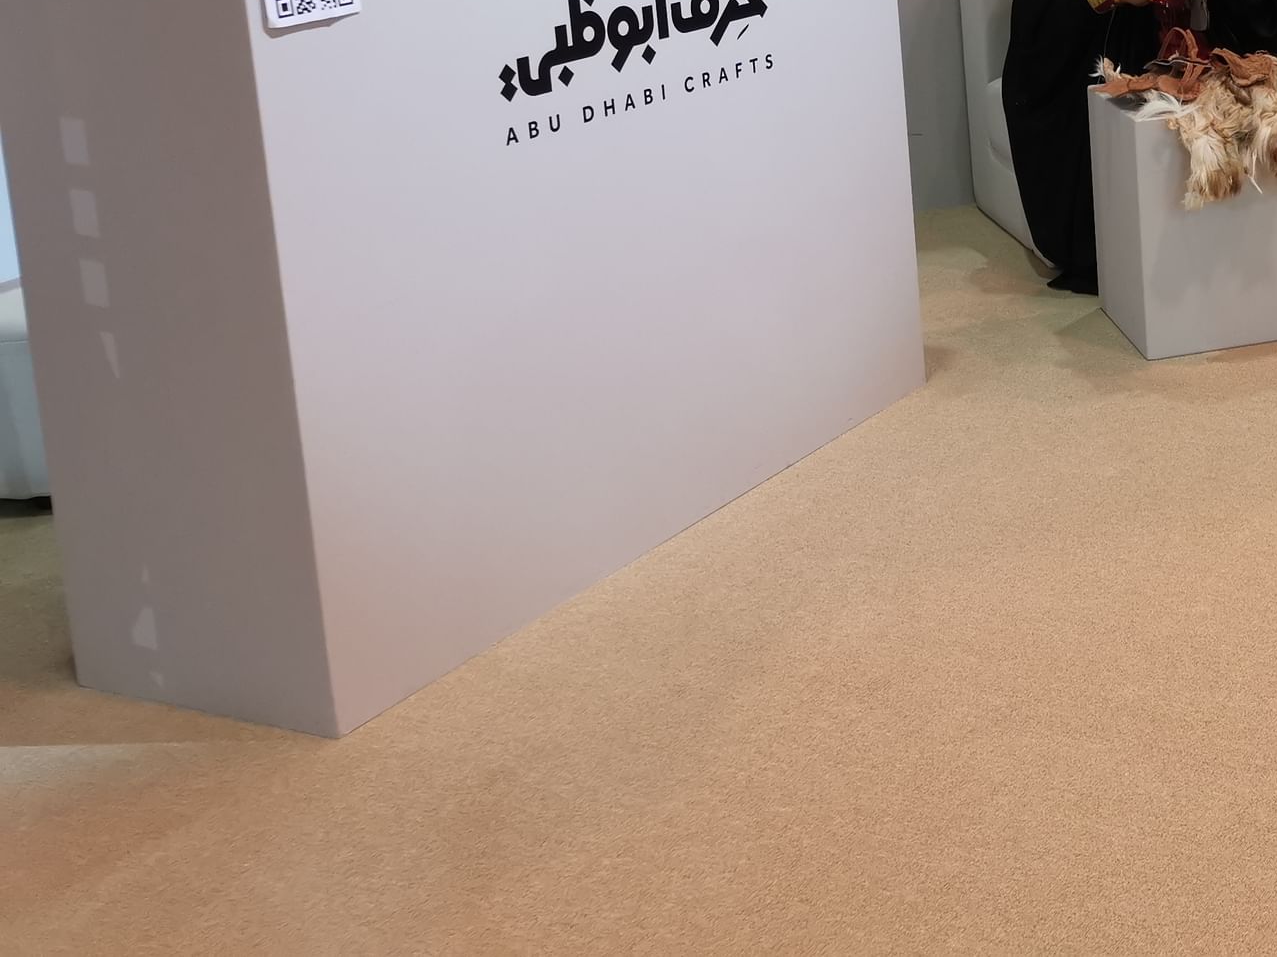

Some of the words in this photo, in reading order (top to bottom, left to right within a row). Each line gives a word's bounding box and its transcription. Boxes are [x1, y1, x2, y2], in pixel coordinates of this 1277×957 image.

[506, 113, 561, 146] ABU
[582, 83, 666, 123] DHABI
[684, 53, 774, 93] CRAFTS
